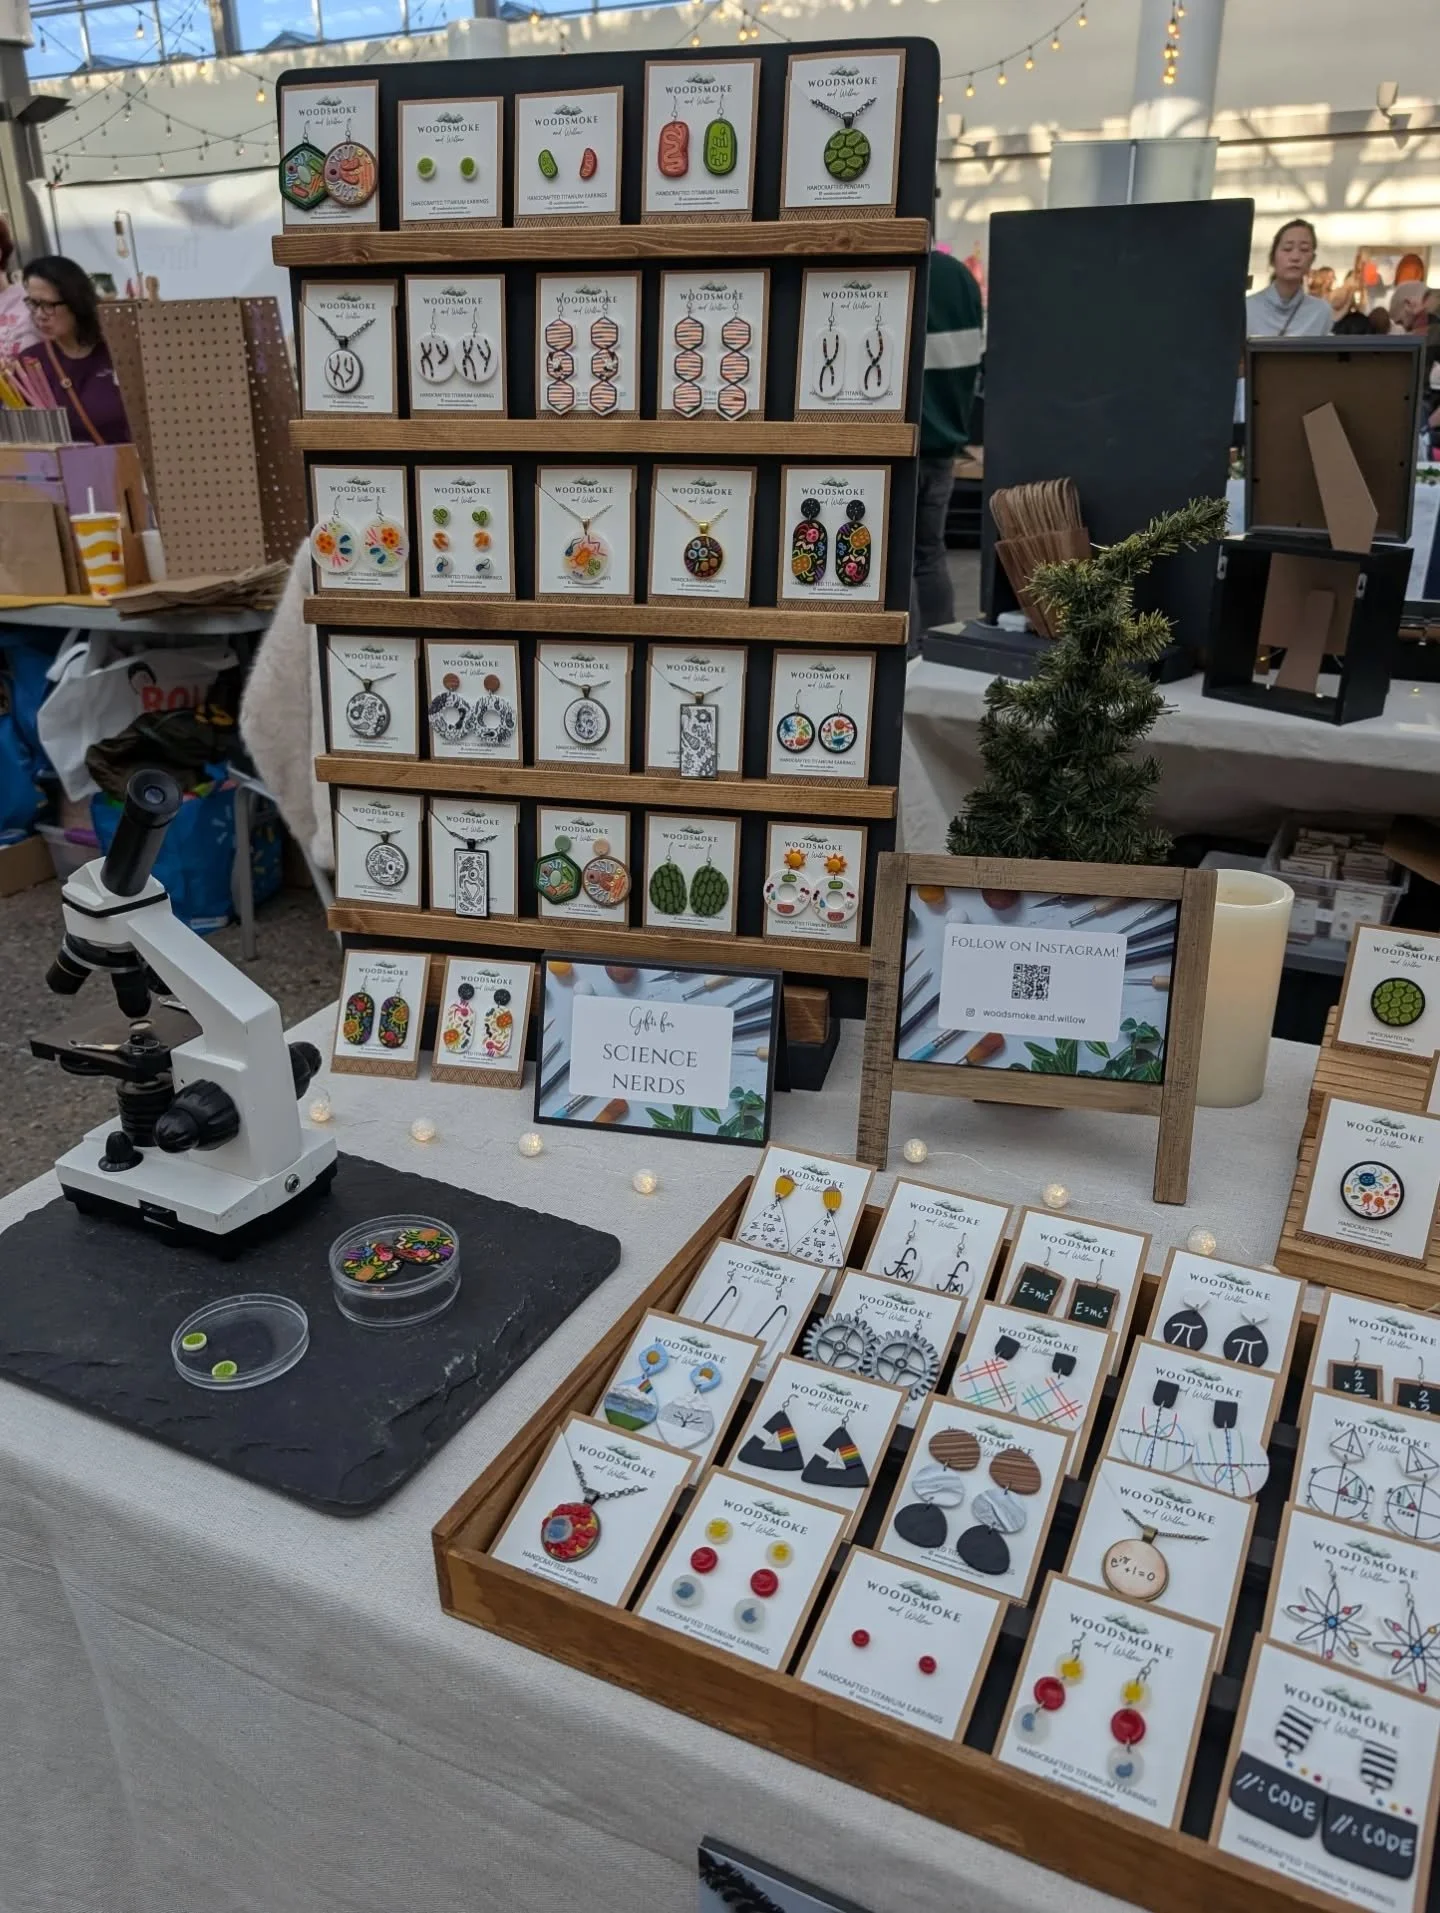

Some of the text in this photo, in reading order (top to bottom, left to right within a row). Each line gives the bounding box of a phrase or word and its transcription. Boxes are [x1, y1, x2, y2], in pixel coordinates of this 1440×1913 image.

[666, 85, 732, 94] WOODSMOKE
[809, 77, 878, 87] WOODSMOKE
[299, 106, 357, 116] WOODSMOKE
[535, 116, 599, 126] WOODSMOKE
[418, 124, 480, 133] WOODSMOKE
[823, 291, 888, 299] WOODSMOKE
[672, 488, 732, 496] WOODSMOKE
[345, 653, 399, 661] WOODSMOKE
[553, 661, 609, 670] WOODSMOKE
[667, 664, 726, 673] WOODSMOKE
[791, 672, 850, 680] WOODSMOKE
[352, 807, 405, 817] WOODSMOKE
[446, 816, 500, 825] WOODSMOKE
[555, 825, 608, 834] WOODSMOKE
[662, 833, 718, 842] WOODSMOKE
[785, 841, 842, 851] WOODSMOKE
[359, 968, 408, 976] WOODSMOKE
[461, 975, 513, 985] WOODSMOKE
[629, 1007, 674, 1035] Gifts for
[983, 1009, 1085, 1025] woodsmoke.and.willow
[603, 1044, 697, 1068] SCIENCE
[612, 1074, 685, 1095] NERDS
[1346, 1120, 1424, 1143] WOODSMOKE
[780, 1166, 845, 1188] WOODSMOKE
[910, 1202, 980, 1226] WOODSMOKE
[1040, 1233, 1116, 1257] WOODSMOKE
[728, 1260, 796, 1283] WOODSMOKE
[1190, 1272, 1271, 1300] WOODSMOKE
[859, 1294, 932, 1319] WOODSMOKE
[999, 1326, 1079, 1353] WOODSMOKE
[1348, 1316, 1437, 1346] WOODSMOKE
[655, 1336, 727, 1364] WOODSMOKE
[1155, 1367, 1243, 1399] WOODSMOKE
[791, 1382, 870, 1412] WOODSMOKE
[1334, 1418, 1432, 1449] WOODSMOKE
[578, 1443, 657, 1479] WOODSMOKE
[723, 1499, 809, 1535] WOODSMOKE
[1120, 1486, 1217, 1525] WOODSMOKE
[522, 1550, 599, 1585] HANDCRAFTED PENDANTS
[1313, 1540, 1419, 1580] WOODSMOKE
[867, 1580, 963, 1623] WOODSMOKE
[656, 1605, 704, 1629] HANDCRAFTED
[1069, 1613, 1174, 1659] WOODSMOKE
[818, 1668, 943, 1725] HANDCRAFTED TITANIUM EARRINGS
[1283, 1683, 1401, 1739] WOODSMOKE
[1267, 1784, 1317, 1821] CODE
[1363, 1824, 1413, 1856] CODE
